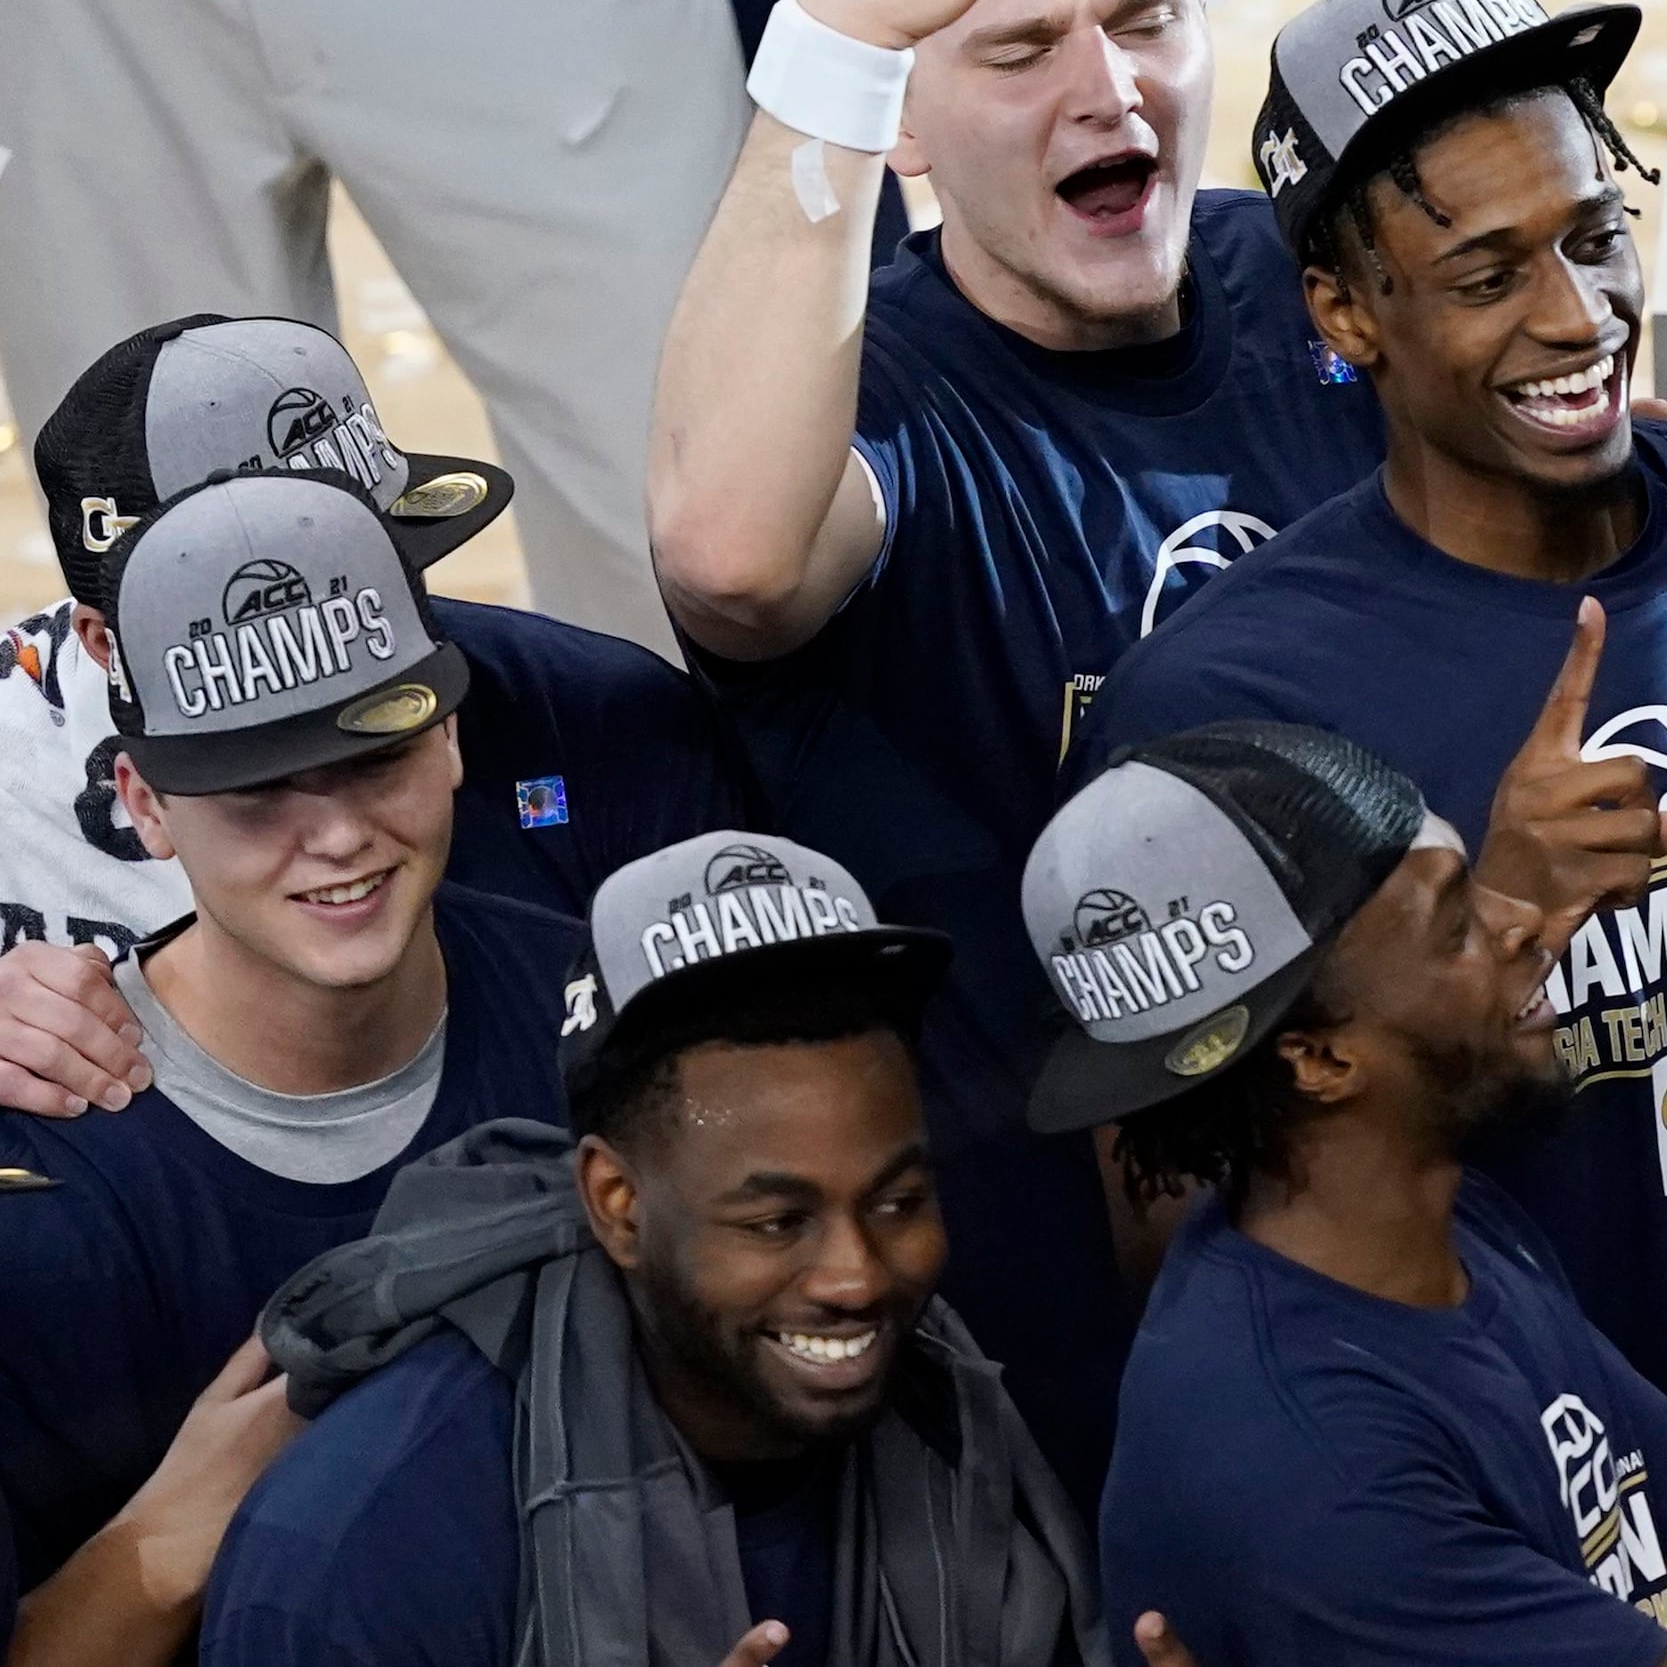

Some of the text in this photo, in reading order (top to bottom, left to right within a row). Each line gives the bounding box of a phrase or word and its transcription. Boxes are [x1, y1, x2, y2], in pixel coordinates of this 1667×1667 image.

[235, 577, 306, 621] ACC
[330, 575, 348, 595] 21
[188, 617, 211, 638] 20
[164, 587, 396, 718] CHAMPS
[717, 864, 786, 891] ACC
[1169, 896, 1189, 917] 21
[641, 885, 858, 978] CHAMPS
[1088, 909, 1144, 944] ACC
[1051, 900, 1255, 1023] CHAMPS
